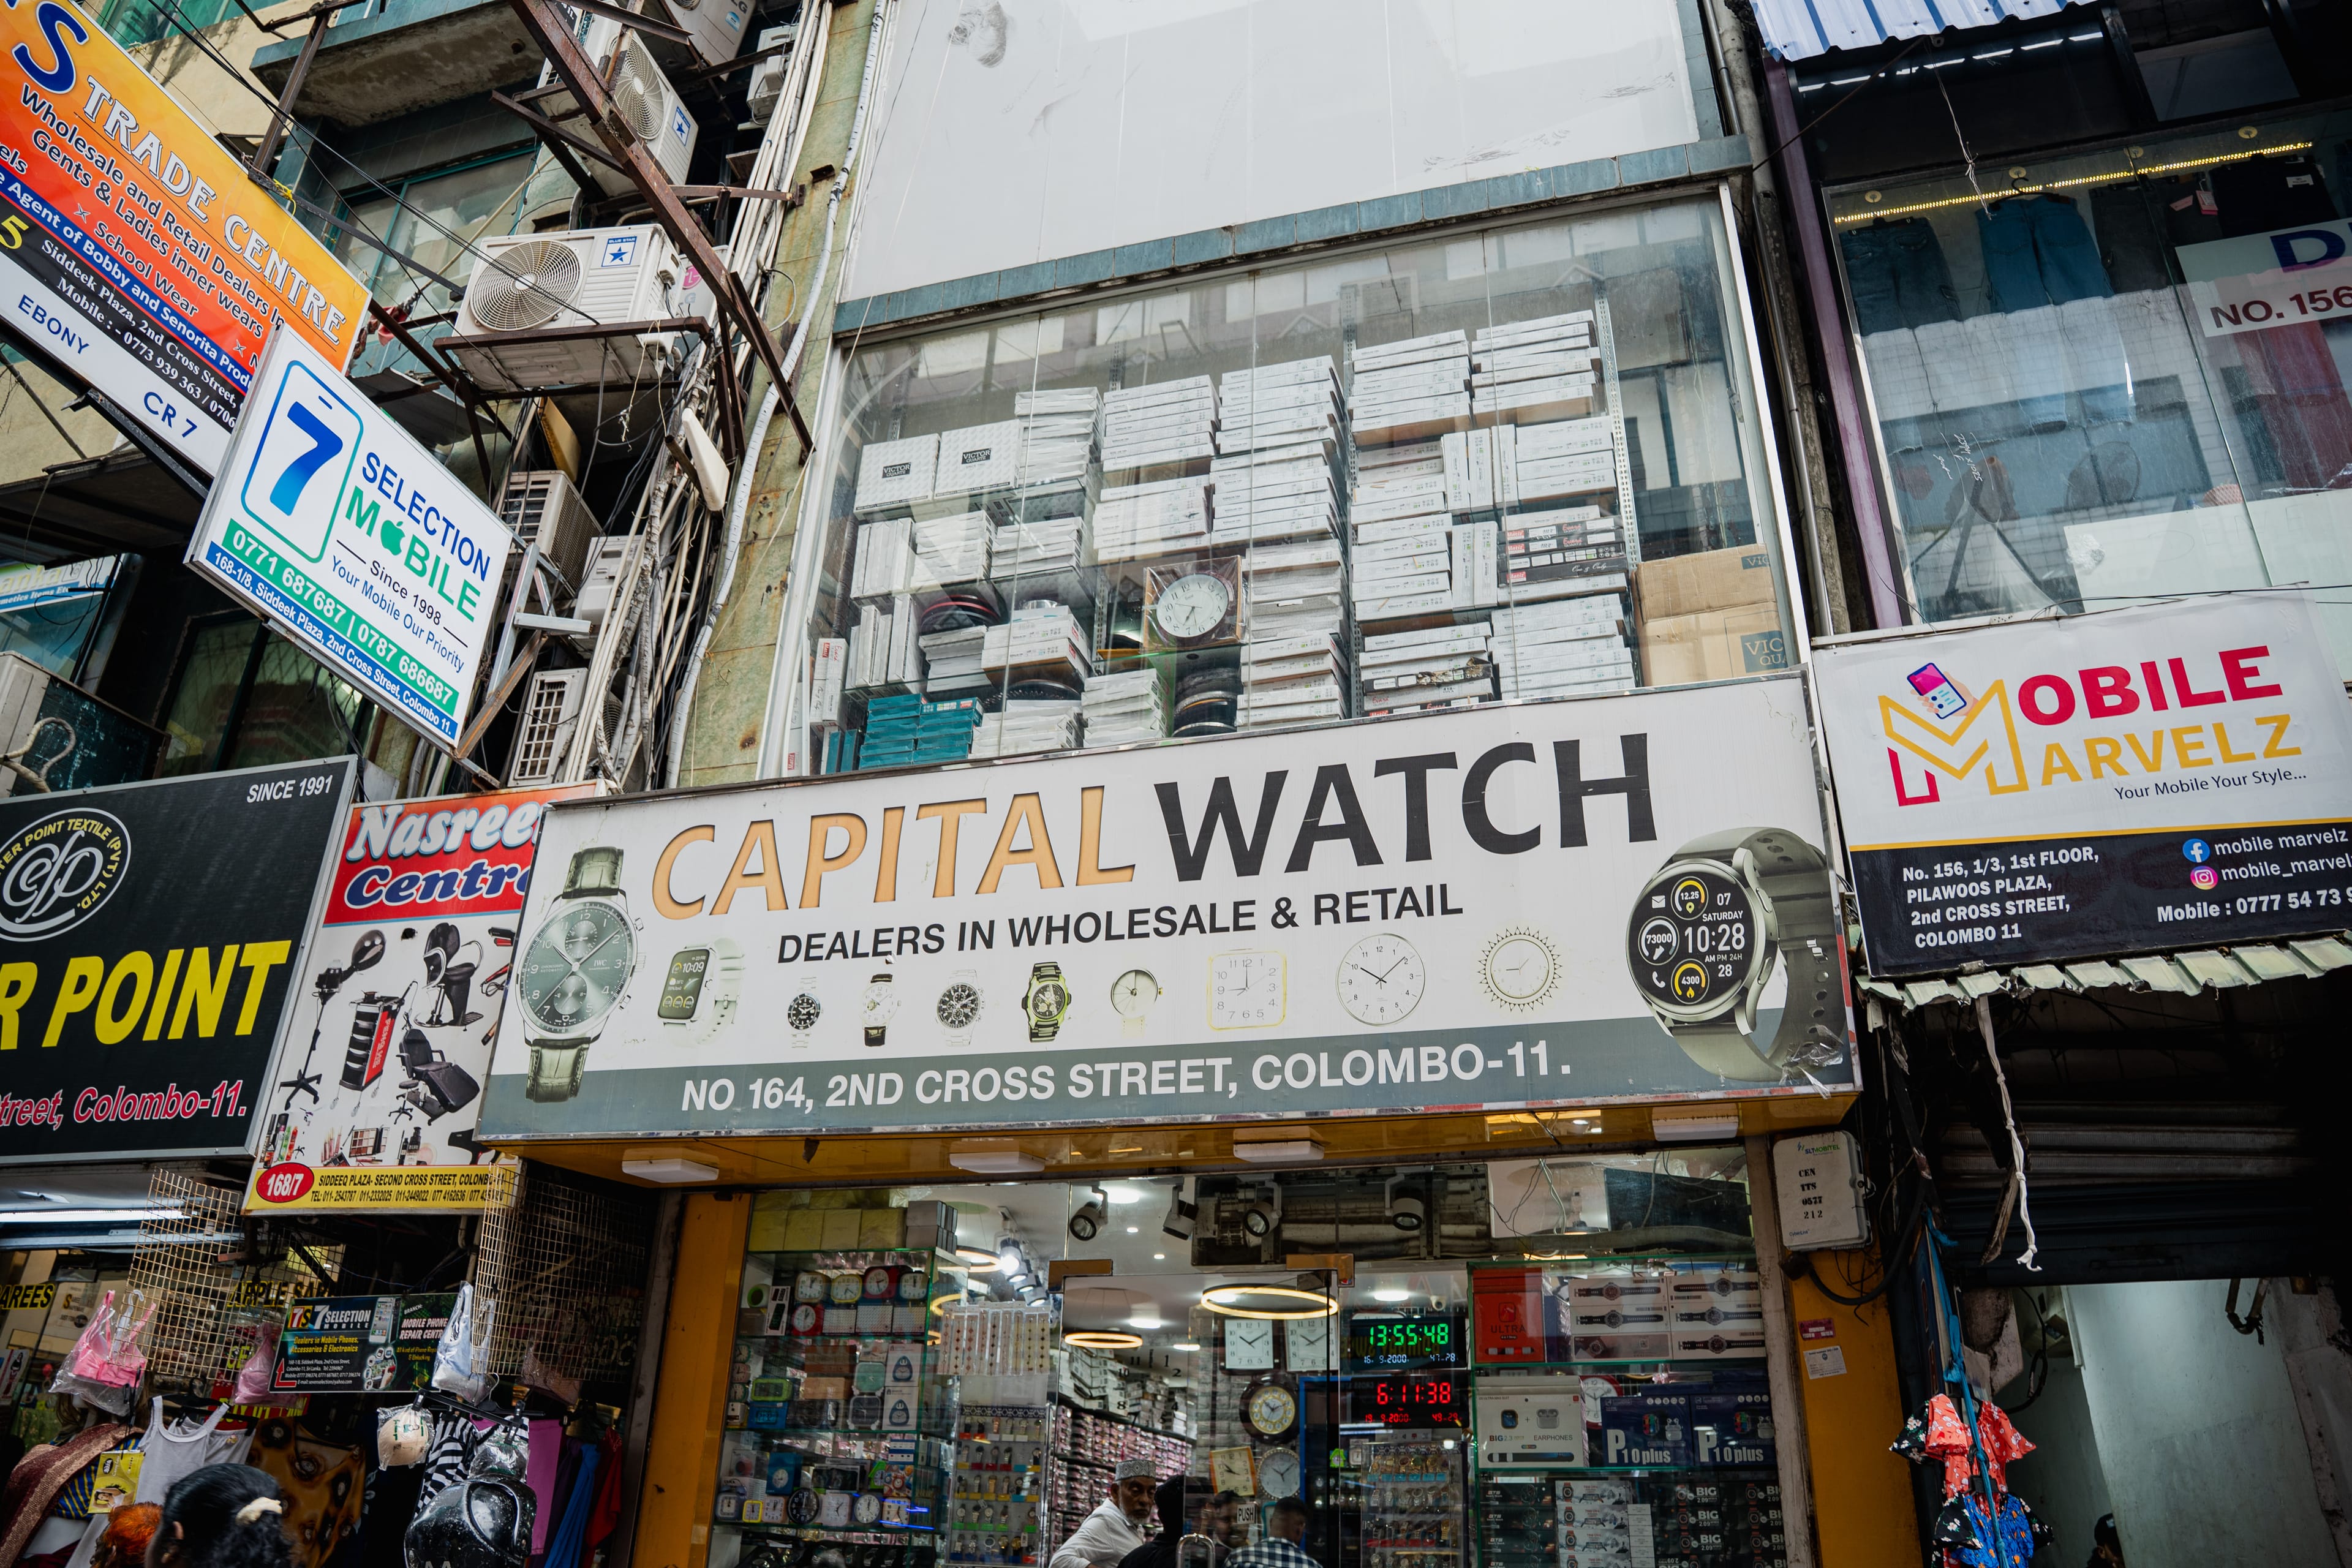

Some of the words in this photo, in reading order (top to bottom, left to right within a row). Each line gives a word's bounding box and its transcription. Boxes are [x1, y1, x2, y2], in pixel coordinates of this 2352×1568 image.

[21, 83, 124, 186] Wholesale
[126, 181, 162, 219] and
[162, 211, 212, 263] Retail
[211, 254, 270, 317] Dealers
[83, 75, 217, 224] TRADE
[224, 214, 347, 347] CENTRE
[32, 129, 92, 187] Gents
[95, 180, 111, 206] &
[115, 197, 170, 257] Ladies
[170, 247, 216, 295] inner
[217, 290, 264, 339] wears
[94, 221, 153, 279] School
[154, 271, 199, 317] Wear
[7, 182, 61, 228] Agent
[62, 225, 83, 244] of
[82, 239, 130, 287] Bobby
[131, 284, 160, 312] and
[160, 307, 218, 360] Senorita
[219, 353, 252, 388] Prod
[18, 294, 89, 354] EBONY
[42, 239, 97, 292] Siddeek
[98, 285, 136, 326] Plaza,
[138, 320, 164, 346] 2nd
[166, 341, 200, 375] Cross
[201, 369, 237, 408] Street,
[2210, 300, 2285, 328] NO.
[56, 277, 105, 323] Mobile
[123, 331, 154, 361] 0773
[156, 356, 179, 380] 939
[179, 376, 202, 399] 363
[143, 391, 176, 428] CR
[181, 418, 198, 438] 7
[270, 401, 344, 516] 7
[883, 464, 911, 473] VICTOR
[962, 450, 991, 459] VICTOR
[361, 451, 491, 582] SELECTION
[0, 593, 29, 605] metics
[30, 587, 55, 600] Items
[370, 560, 408, 598] Since
[413, 594, 441, 625] 1998
[233, 530, 278, 575] 0771
[282, 567, 347, 623] 687687
[358, 624, 398, 662] 0787
[398, 655, 453, 705] 686687
[332, 555, 360, 588] Your
[361, 580, 400, 620] Mobile
[403, 614, 424, 638] Our
[426, 631, 464, 673] Priority
[215, 552, 253, 592] 168-1/8,
[255, 582, 296, 621] Siddeek
[296, 611, 325, 644] Plaza,
[326, 634, 346, 656] 2nd
[346, 647, 372, 677] Cross
[373, 669, 400, 699] Street,
[402, 687, 439, 726] Colombo
[440, 717, 451, 735] 11.
[1745, 638, 1784, 656] VIC
[246, 779, 296, 804] SINCE
[298, 775, 333, 797] 1991
[2114, 787, 2150, 800] Your
[2155, 778, 2209, 796] Mobile
[2211, 775, 2248, 789] Your
[2252, 767, 2307, 786] Style...
[24, 820, 65, 846] POINT
[67, 818, 112, 841] TEXTILE
[347, 801, 541, 861] Nasree
[652, 785, 1137, 921] CAPITAL
[1154, 733, 1659, 883] WATCH
[2215, 837, 2273, 856] mobile
[2278, 828, 2348, 848] marvelz
[0, 843, 23, 875] TER
[102, 836, 122, 878] (PVT)
[1902, 867, 1929, 882] No.
[1934, 861, 1968, 878] 156,
[1973, 857, 2005, 876] 1/3,
[2010, 853, 2036, 870] 1st
[2040, 846, 2099, 866] FLOOR,
[2221, 852, 2352, 881] mobile_marvel
[77, 880, 107, 909] LTD.
[1680, 891, 1700, 900] 12.25
[1717, 893, 1732, 906] 07
[1907, 881, 1991, 903] PILAWOOS
[1996, 875, 2052, 894] PLAZA,
[1702, 910, 1743, 922] SATURDAY
[1911, 909, 1941, 926] 2nd
[1946, 902, 2001, 922] CROSS
[2005, 895, 2070, 916] STREET,
[2157, 902, 2220, 922] Mobile
[2236, 894, 2282, 914] 0777
[2288, 891, 2312, 909] 54
[2316, 888, 2342, 907] 73
[777, 923, 945, 965] DEALERS
[958, 919, 997, 951] IN
[1006, 899, 1257, 948] WHOLESALE
[1270, 897, 1300, 929] &
[1314, 883, 1464, 927] RETAIL
[1646, 933, 1672, 944] 73000
[1684, 922, 1745, 954] 10:28
[1915, 925, 1996, 948] COLOMBO
[2001, 922, 2022, 939] 11
[682, 962, 704, 973] 10:09
[1681, 976, 1700, 985] 4300
[1718, 964, 1732, 977] 28
[0, 961, 37, 1050] R
[40, 940, 292, 1047] POINT
[681, 1078, 734, 1112] NO
[748, 1076, 814, 1115] 164,
[824, 1070, 904, 1108] 2ND
[911, 1063, 1055, 1104] CROSS
[1067, 1056, 1238, 1099] STREET,
[1250, 1039, 1572, 1092] COLOMBO-11.
[0, 1088, 64, 1131] treet,
[73, 1079, 247, 1123] Colombo-11.
[266, 1172, 304, 1197] 168/7
[318, 1175, 349, 1187] SIDDEEQ
[374, 1174, 404, 1186] SECOND
[404, 1174, 428, 1186] CROSS
[429, 1174, 457, 1188] STREET,
[0, 1284, 55, 1310] AREES
[325, 1310, 371, 1323] SELECTION
[1491, 1324, 1526, 1333] ULTRA
[1370, 1323, 1449, 1346] 13:55:48
[1376, 1382, 1451, 1405] 6:11:38
[1642, 1448, 1671, 1464] plus
[1696, 1487, 1717, 1496] BIG
[1238, 1507, 1254, 1521] PUSH
